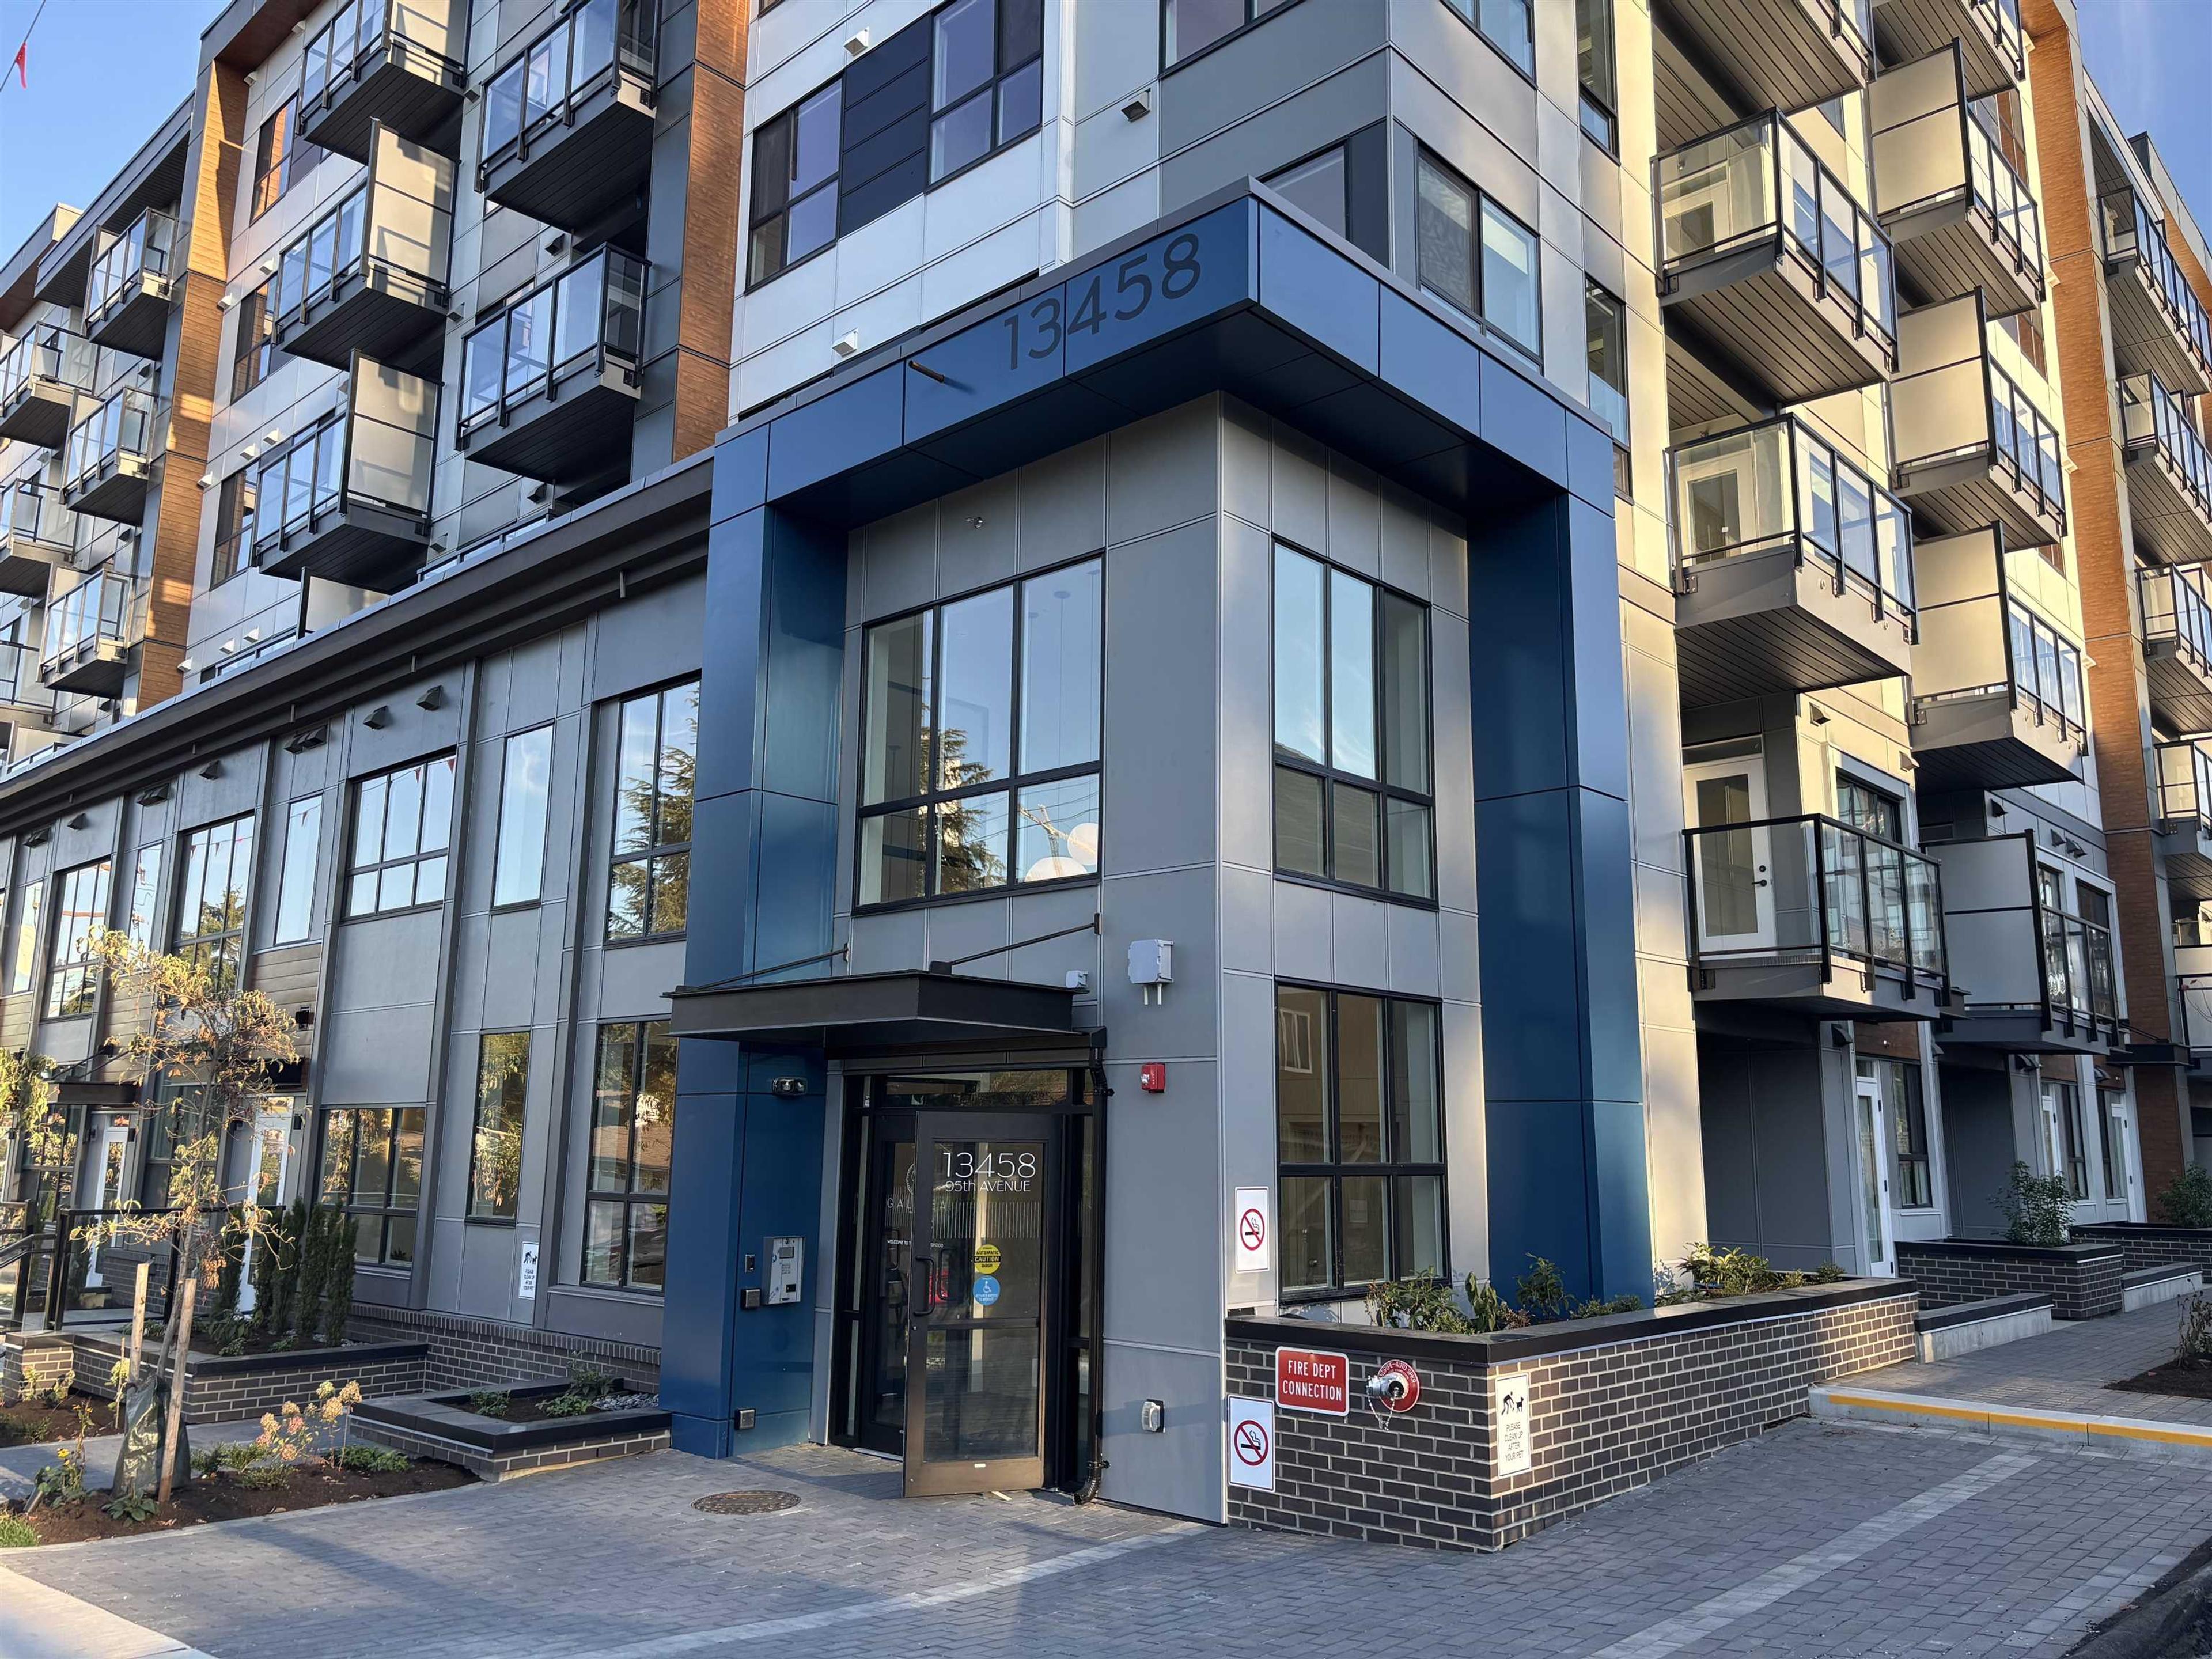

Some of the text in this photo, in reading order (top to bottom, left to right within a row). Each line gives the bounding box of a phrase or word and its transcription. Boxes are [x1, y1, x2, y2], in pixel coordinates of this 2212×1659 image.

[1004, 233, 1200, 370] 13458
[943, 1152, 1036, 1178] 13458
[945, 1180, 1031, 1192] 95th AVENUE
[1288, 1360, 1336, 1379] FIRE DEPT
[1283, 1380, 1342, 1401] CONNECTION
[1506, 1421, 1521, 1432] PLEASE
[1505, 1430, 1524, 1442] CLEAN UP
[1508, 1441, 1521, 1451] AFTER
[1505, 1452, 1516, 1462] YOUR
